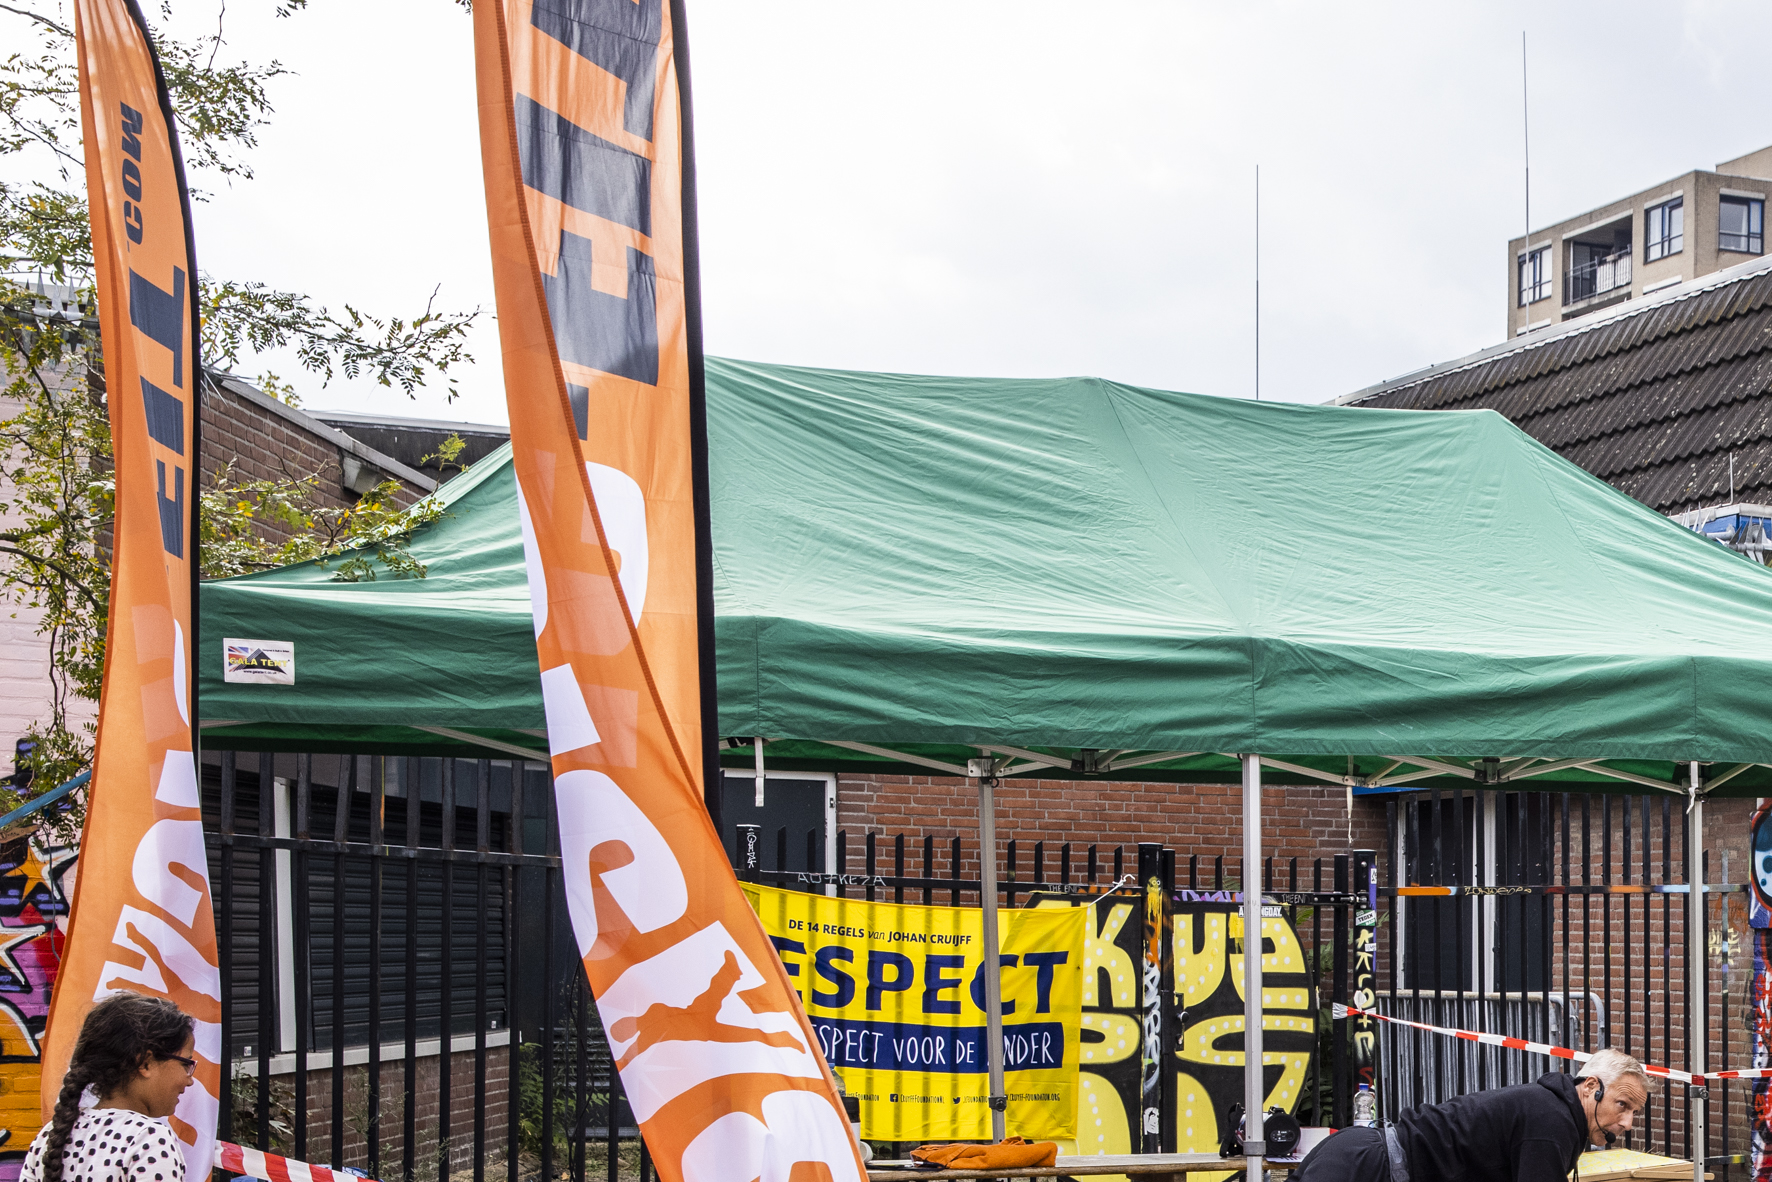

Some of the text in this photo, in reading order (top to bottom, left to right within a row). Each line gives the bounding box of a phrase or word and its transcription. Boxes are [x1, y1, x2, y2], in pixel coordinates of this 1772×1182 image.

[228, 657, 288, 667] GALA TENT
[788, 919, 972, 947] DE 14 REGELS van JOHAN CRUIJFF
[773, 935, 1069, 1016] ESPECT
[893, 1036, 946, 1065] VOOR
[956, 1040, 975, 1064] DE
[987, 1031, 1055, 1066] NDER
